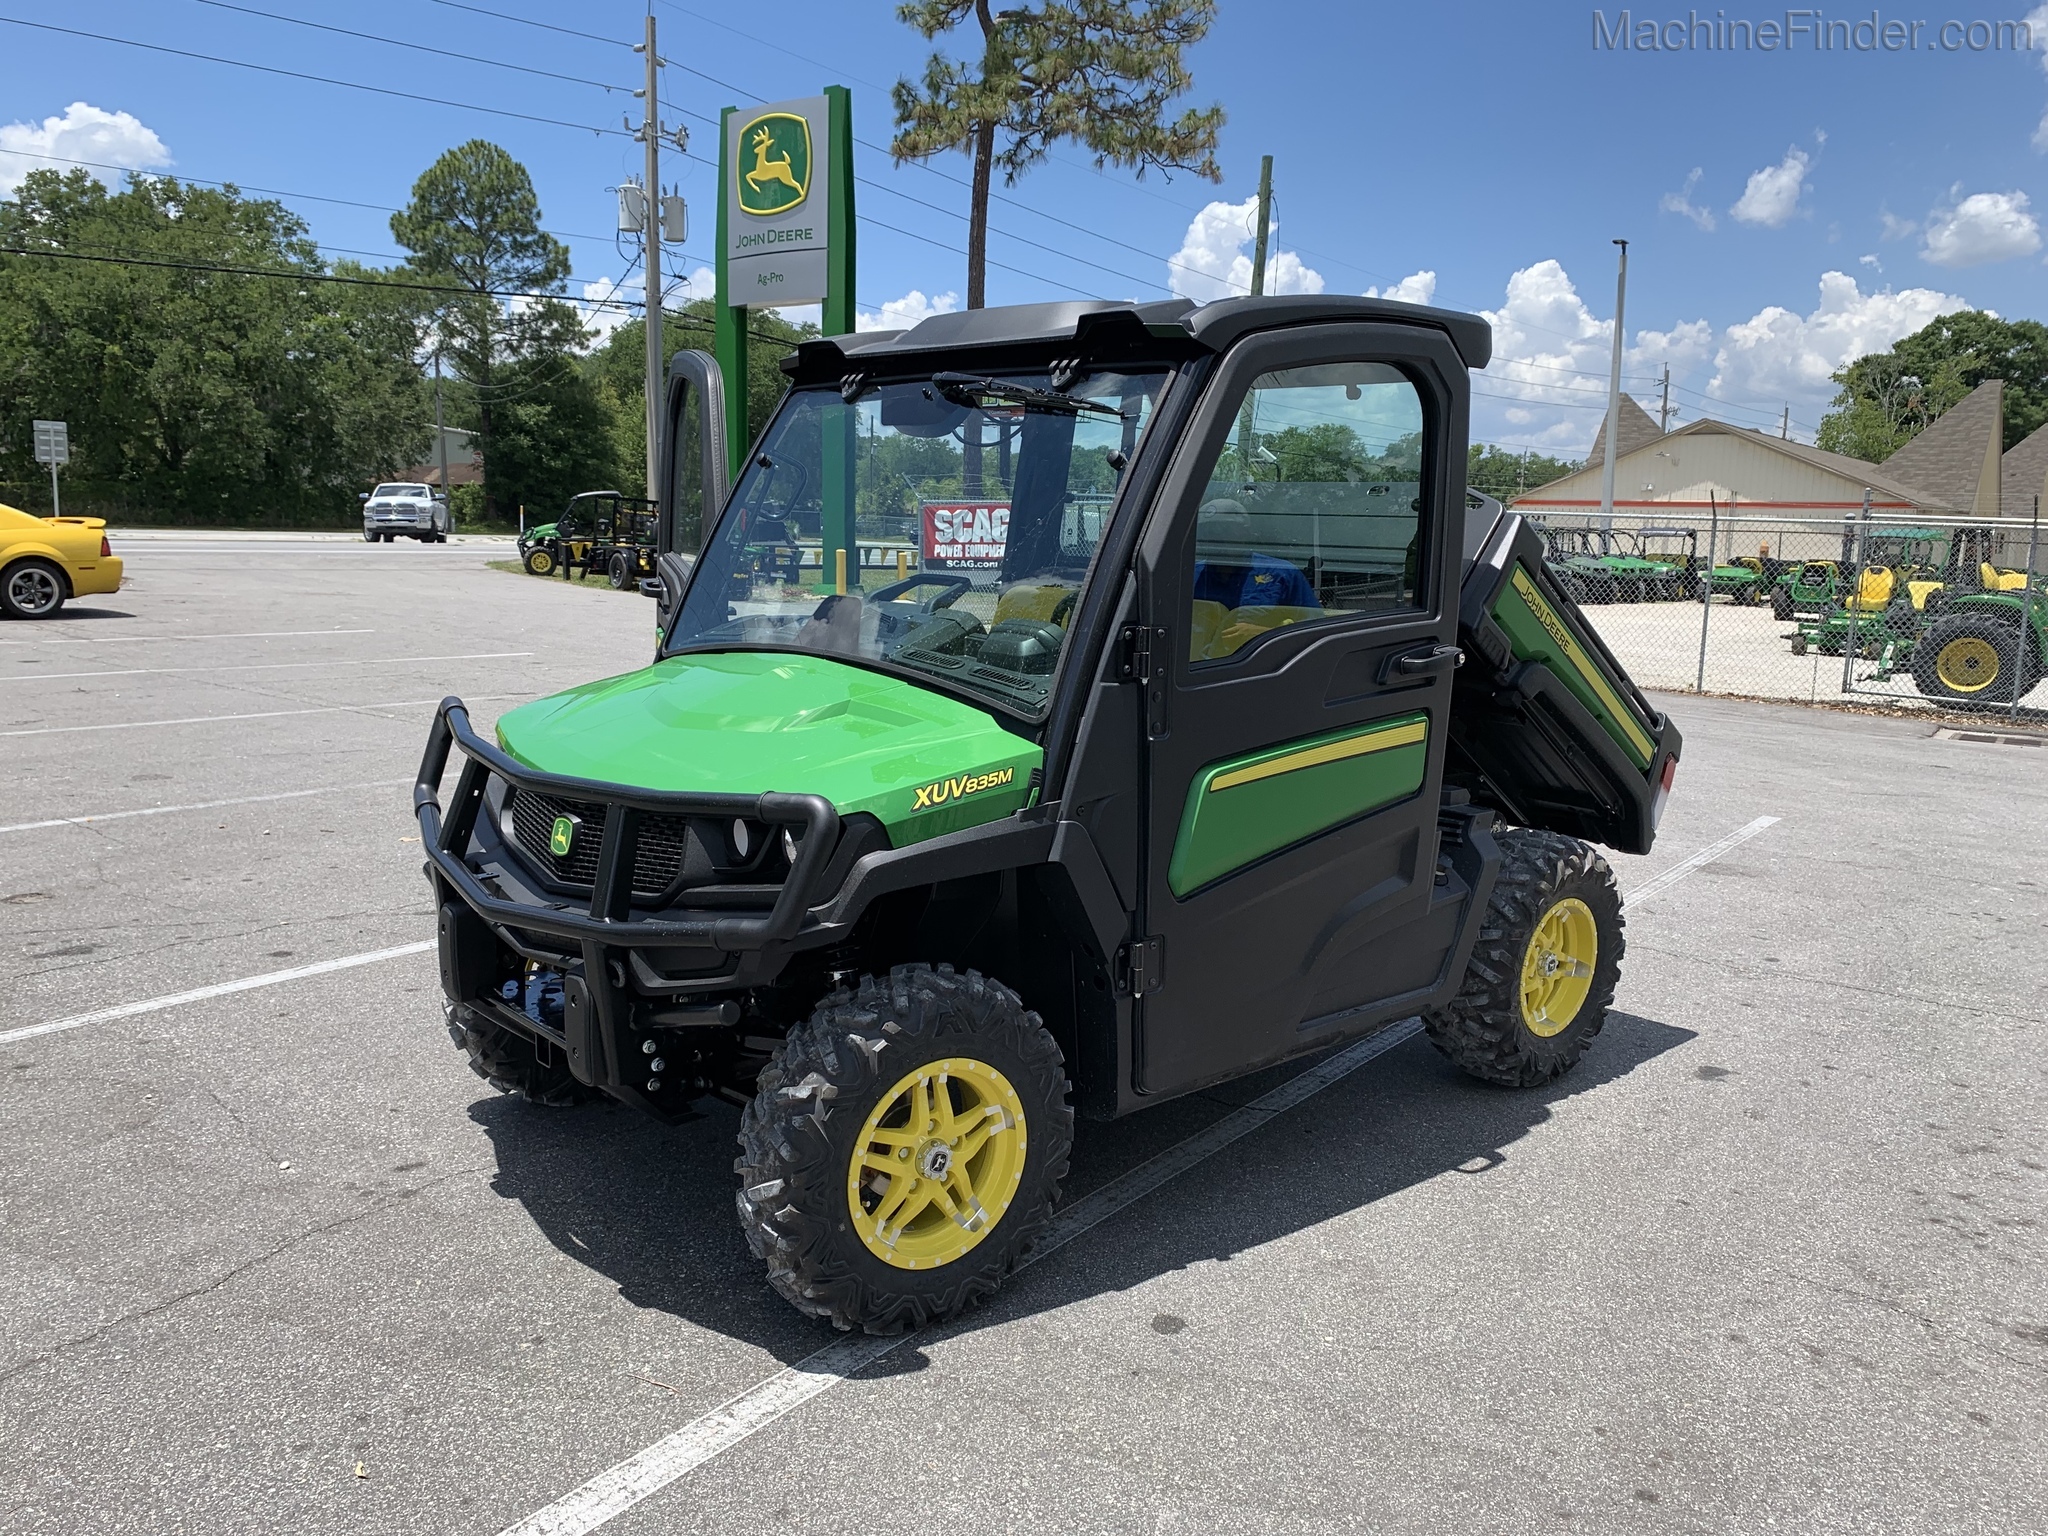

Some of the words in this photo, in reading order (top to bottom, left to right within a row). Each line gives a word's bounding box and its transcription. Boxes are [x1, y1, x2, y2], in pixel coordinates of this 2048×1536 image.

[735, 233, 766, 249] JOHN
[767, 228, 813, 244] DEERE
[757, 272, 784, 286] Ag-Pro
[934, 508, 1010, 543] SCAG
[934, 544, 963, 557] POWER
[965, 544, 1006, 557] EQUIPMEN
[946, 560, 998, 568] SCAG.com
[1521, 586, 1545, 618] JOHN
[1543, 612, 1571, 652] DEERE
[911, 768, 1013, 811] XUV835M
